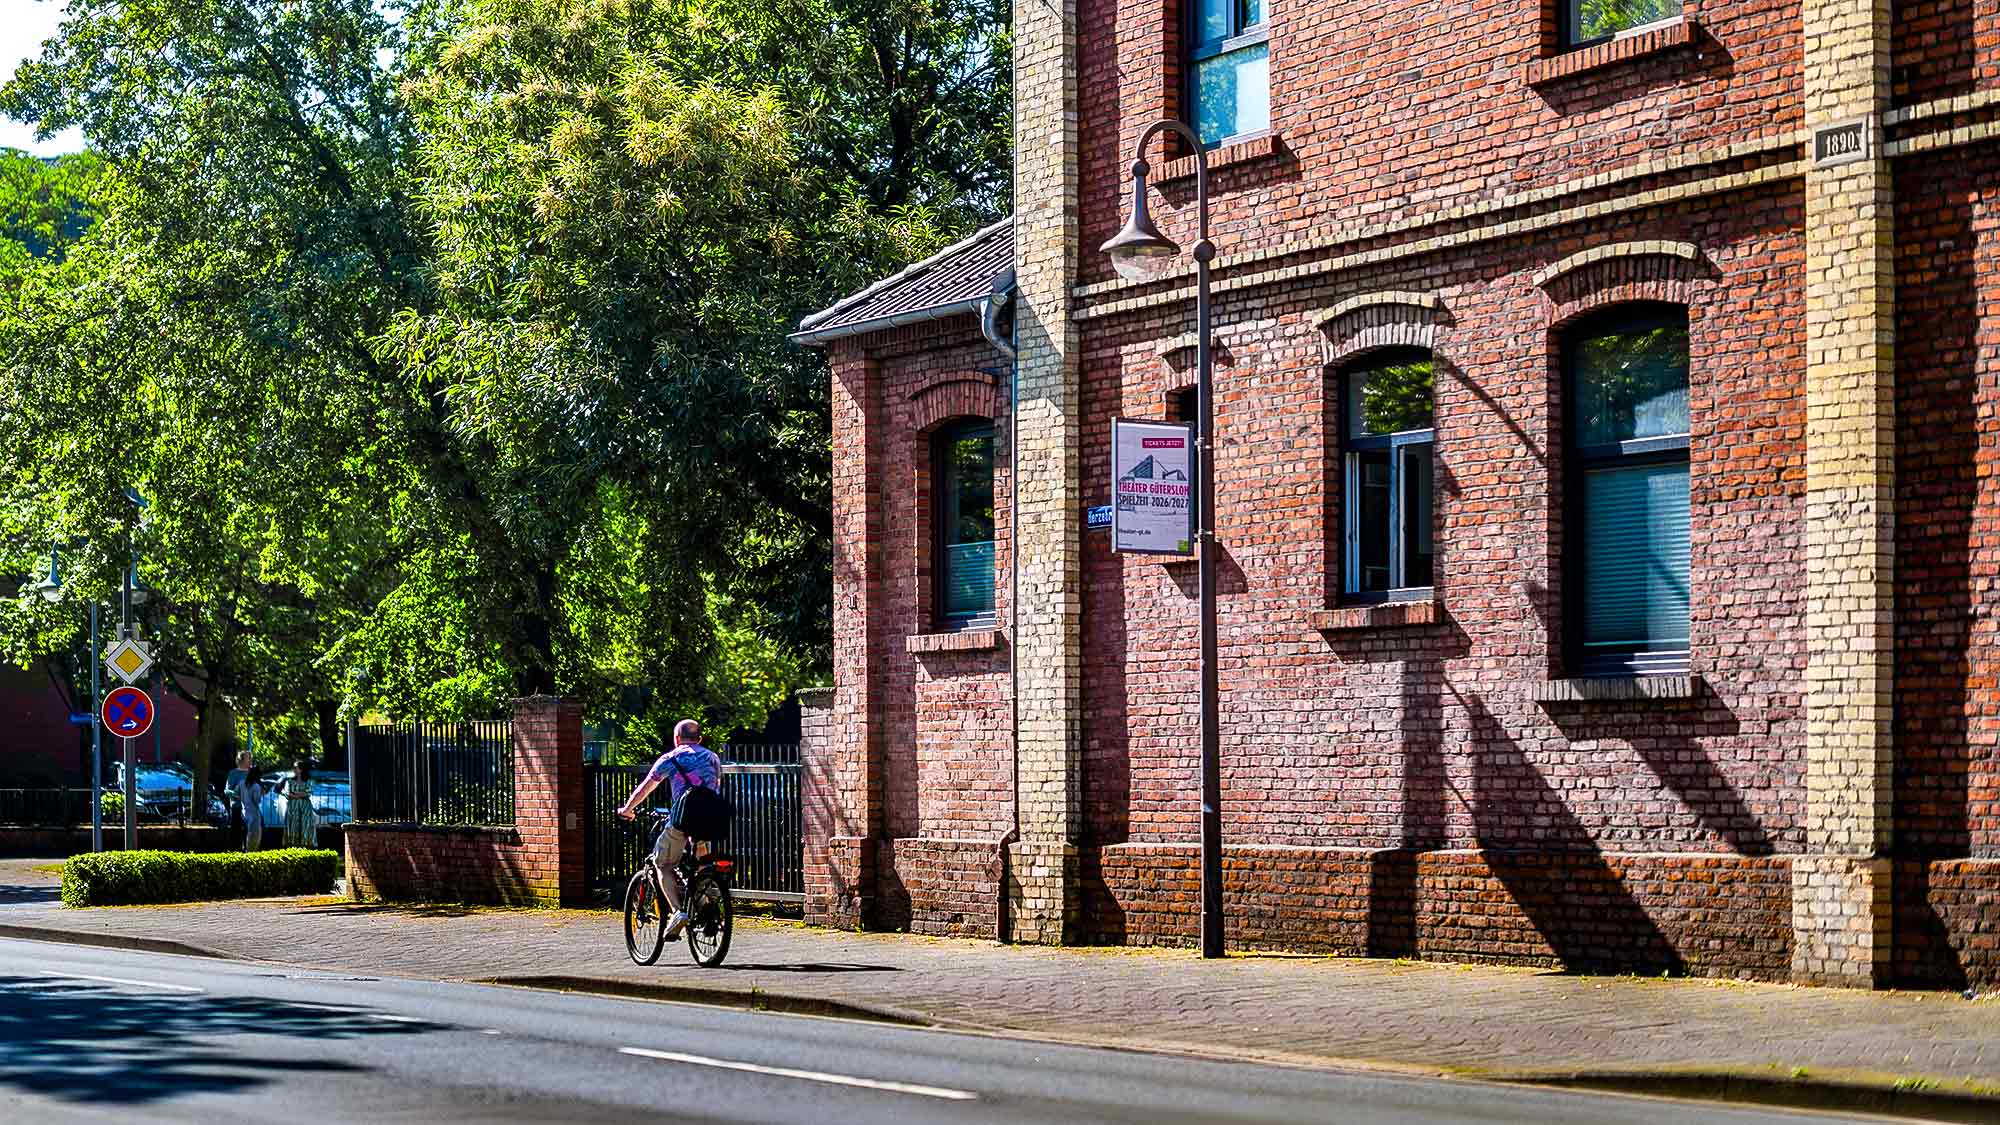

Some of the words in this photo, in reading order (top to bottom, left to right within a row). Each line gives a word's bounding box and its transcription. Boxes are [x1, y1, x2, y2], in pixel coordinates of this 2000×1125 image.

[1119, 482, 1148, 493] THEATER
[1150, 482, 1189, 496] GÜTERSLOH
[1119, 495, 1149, 505] SPIELZEIT
[1151, 496, 1189, 508] 2026/2027
